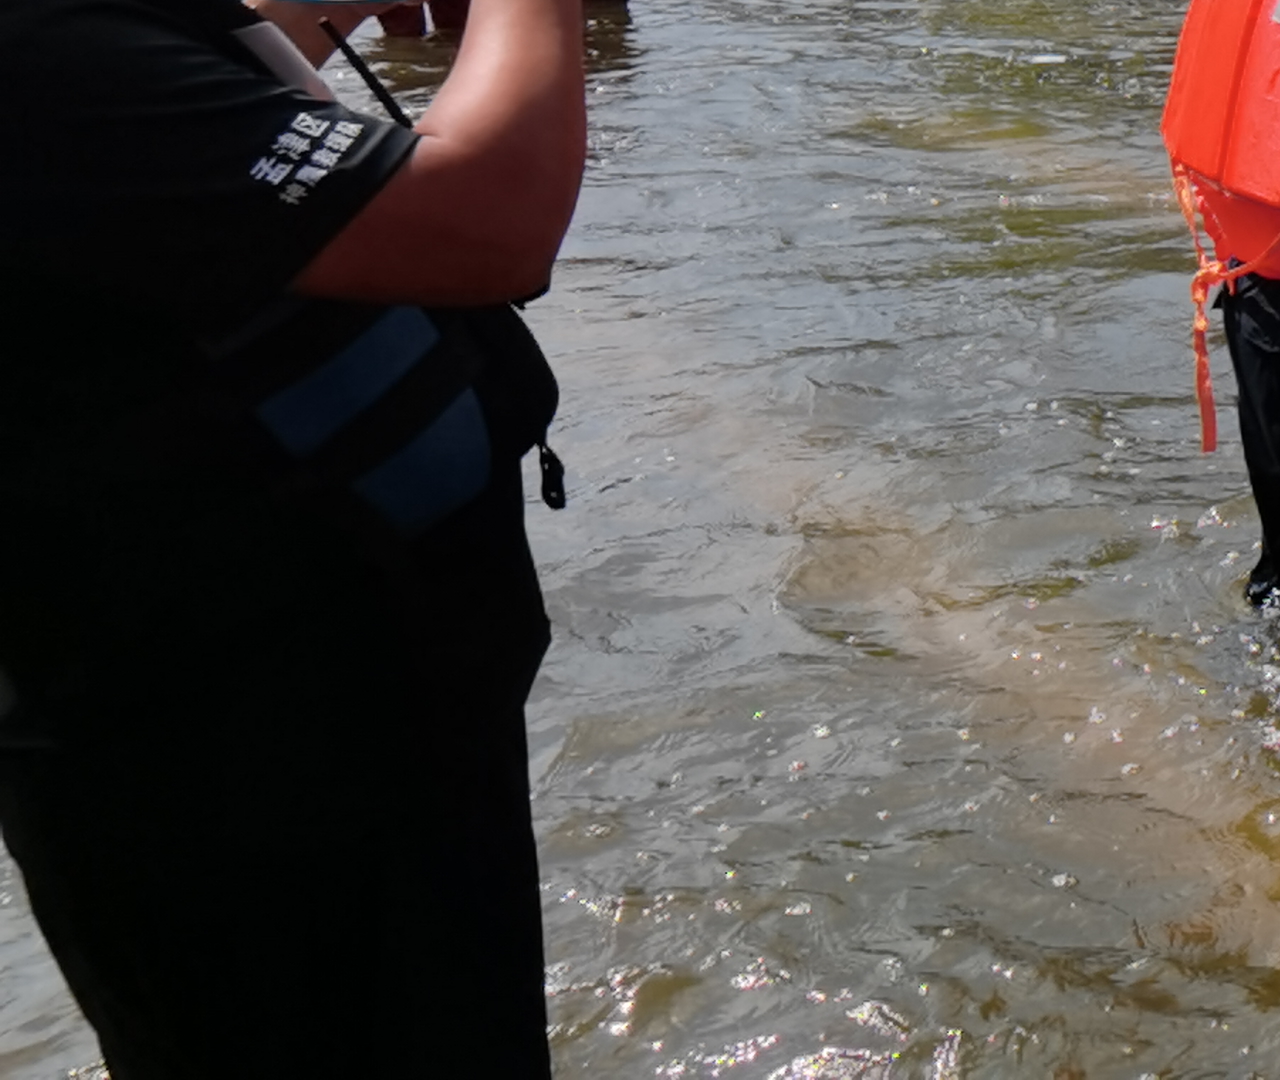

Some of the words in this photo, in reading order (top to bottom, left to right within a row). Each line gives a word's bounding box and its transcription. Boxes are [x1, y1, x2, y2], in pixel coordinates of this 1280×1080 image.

[250, 112, 330, 186] 孟津区
[279, 120, 365, 204] 神鹰救援队
